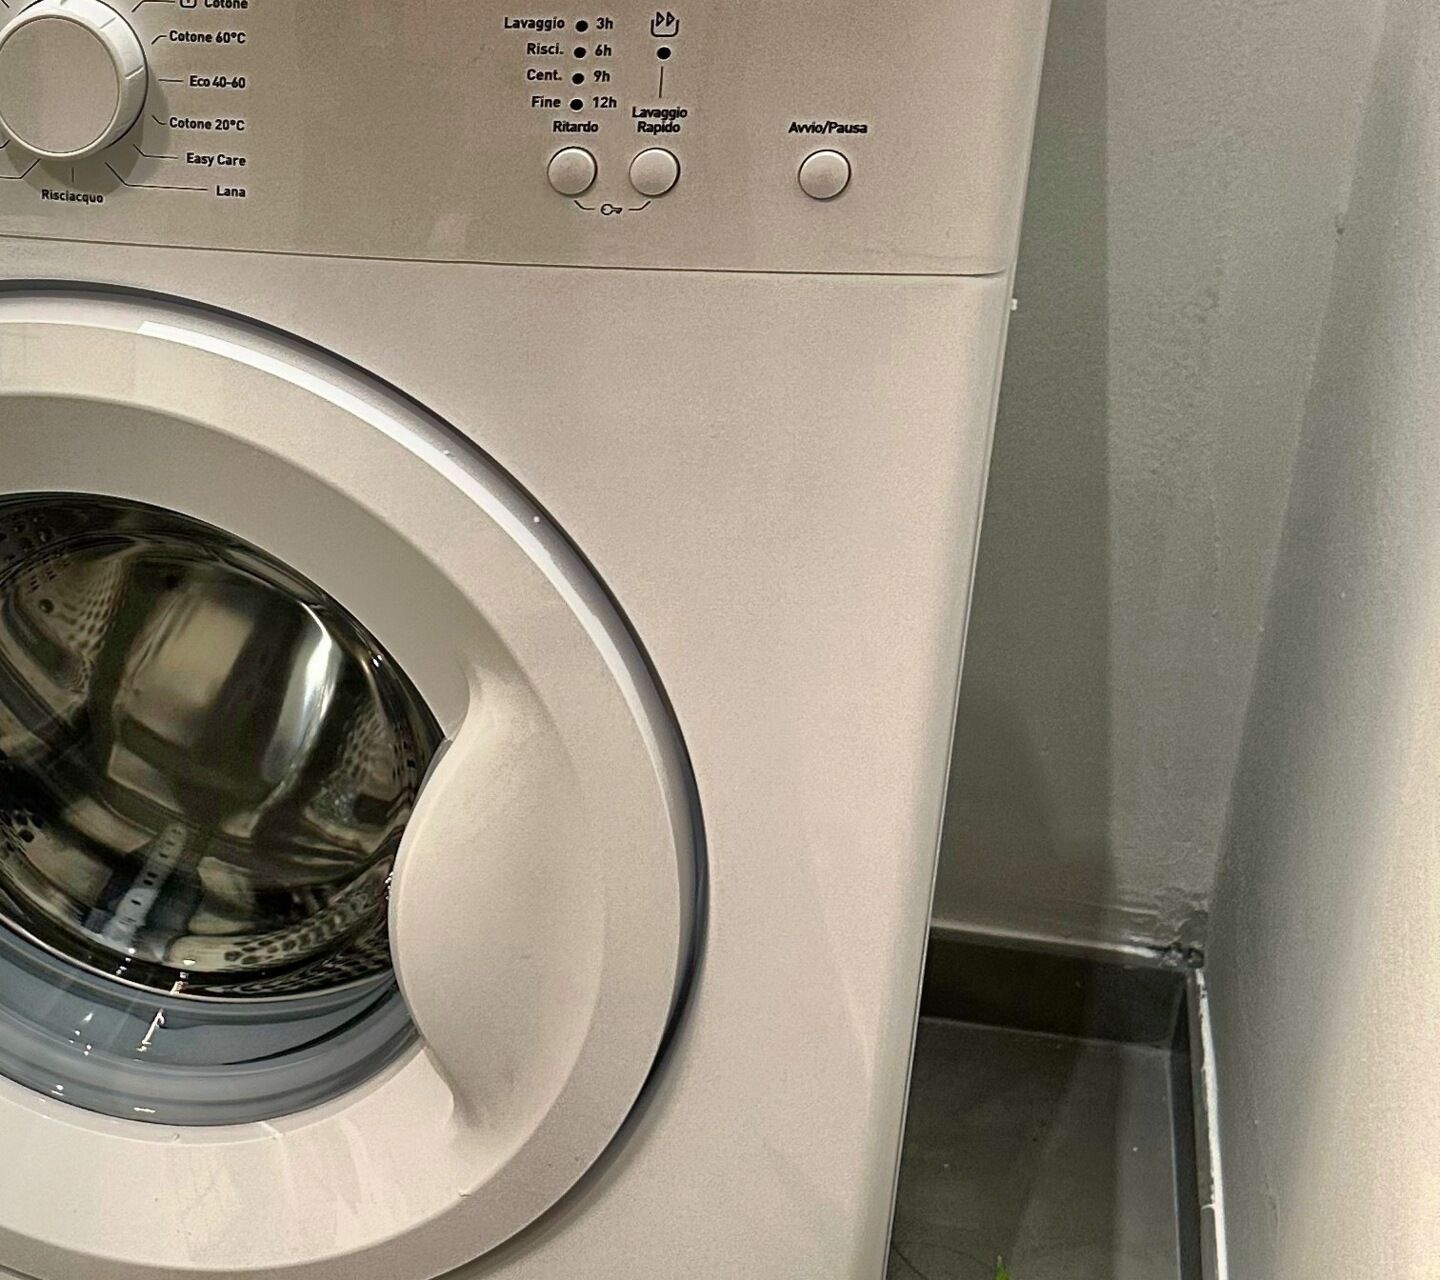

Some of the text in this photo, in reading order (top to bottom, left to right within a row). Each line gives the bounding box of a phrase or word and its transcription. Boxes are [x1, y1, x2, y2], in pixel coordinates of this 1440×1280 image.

[504, 17, 614, 32] Lavaggio 3h
[169, 31, 247, 45] Cotone 60°C
[526, 43, 612, 57] Risci. 6h
[190, 75, 247, 89] Eco 40-60
[526, 69, 611, 83] Cent. 9h
[531, 96, 617, 109] Fine 12h
[632, 106, 688, 121] Lavaggio
[169, 118, 246, 132] Cotone 20°C
[553, 120, 599, 134] Ritardo
[637, 121, 681, 136] Rapido
[788, 121, 868, 135] Avvio/Pausa
[187, 153, 247, 168] Easy Care
[41, 189, 105, 205] Risciacquo
[216, 186, 247, 199] Lana
